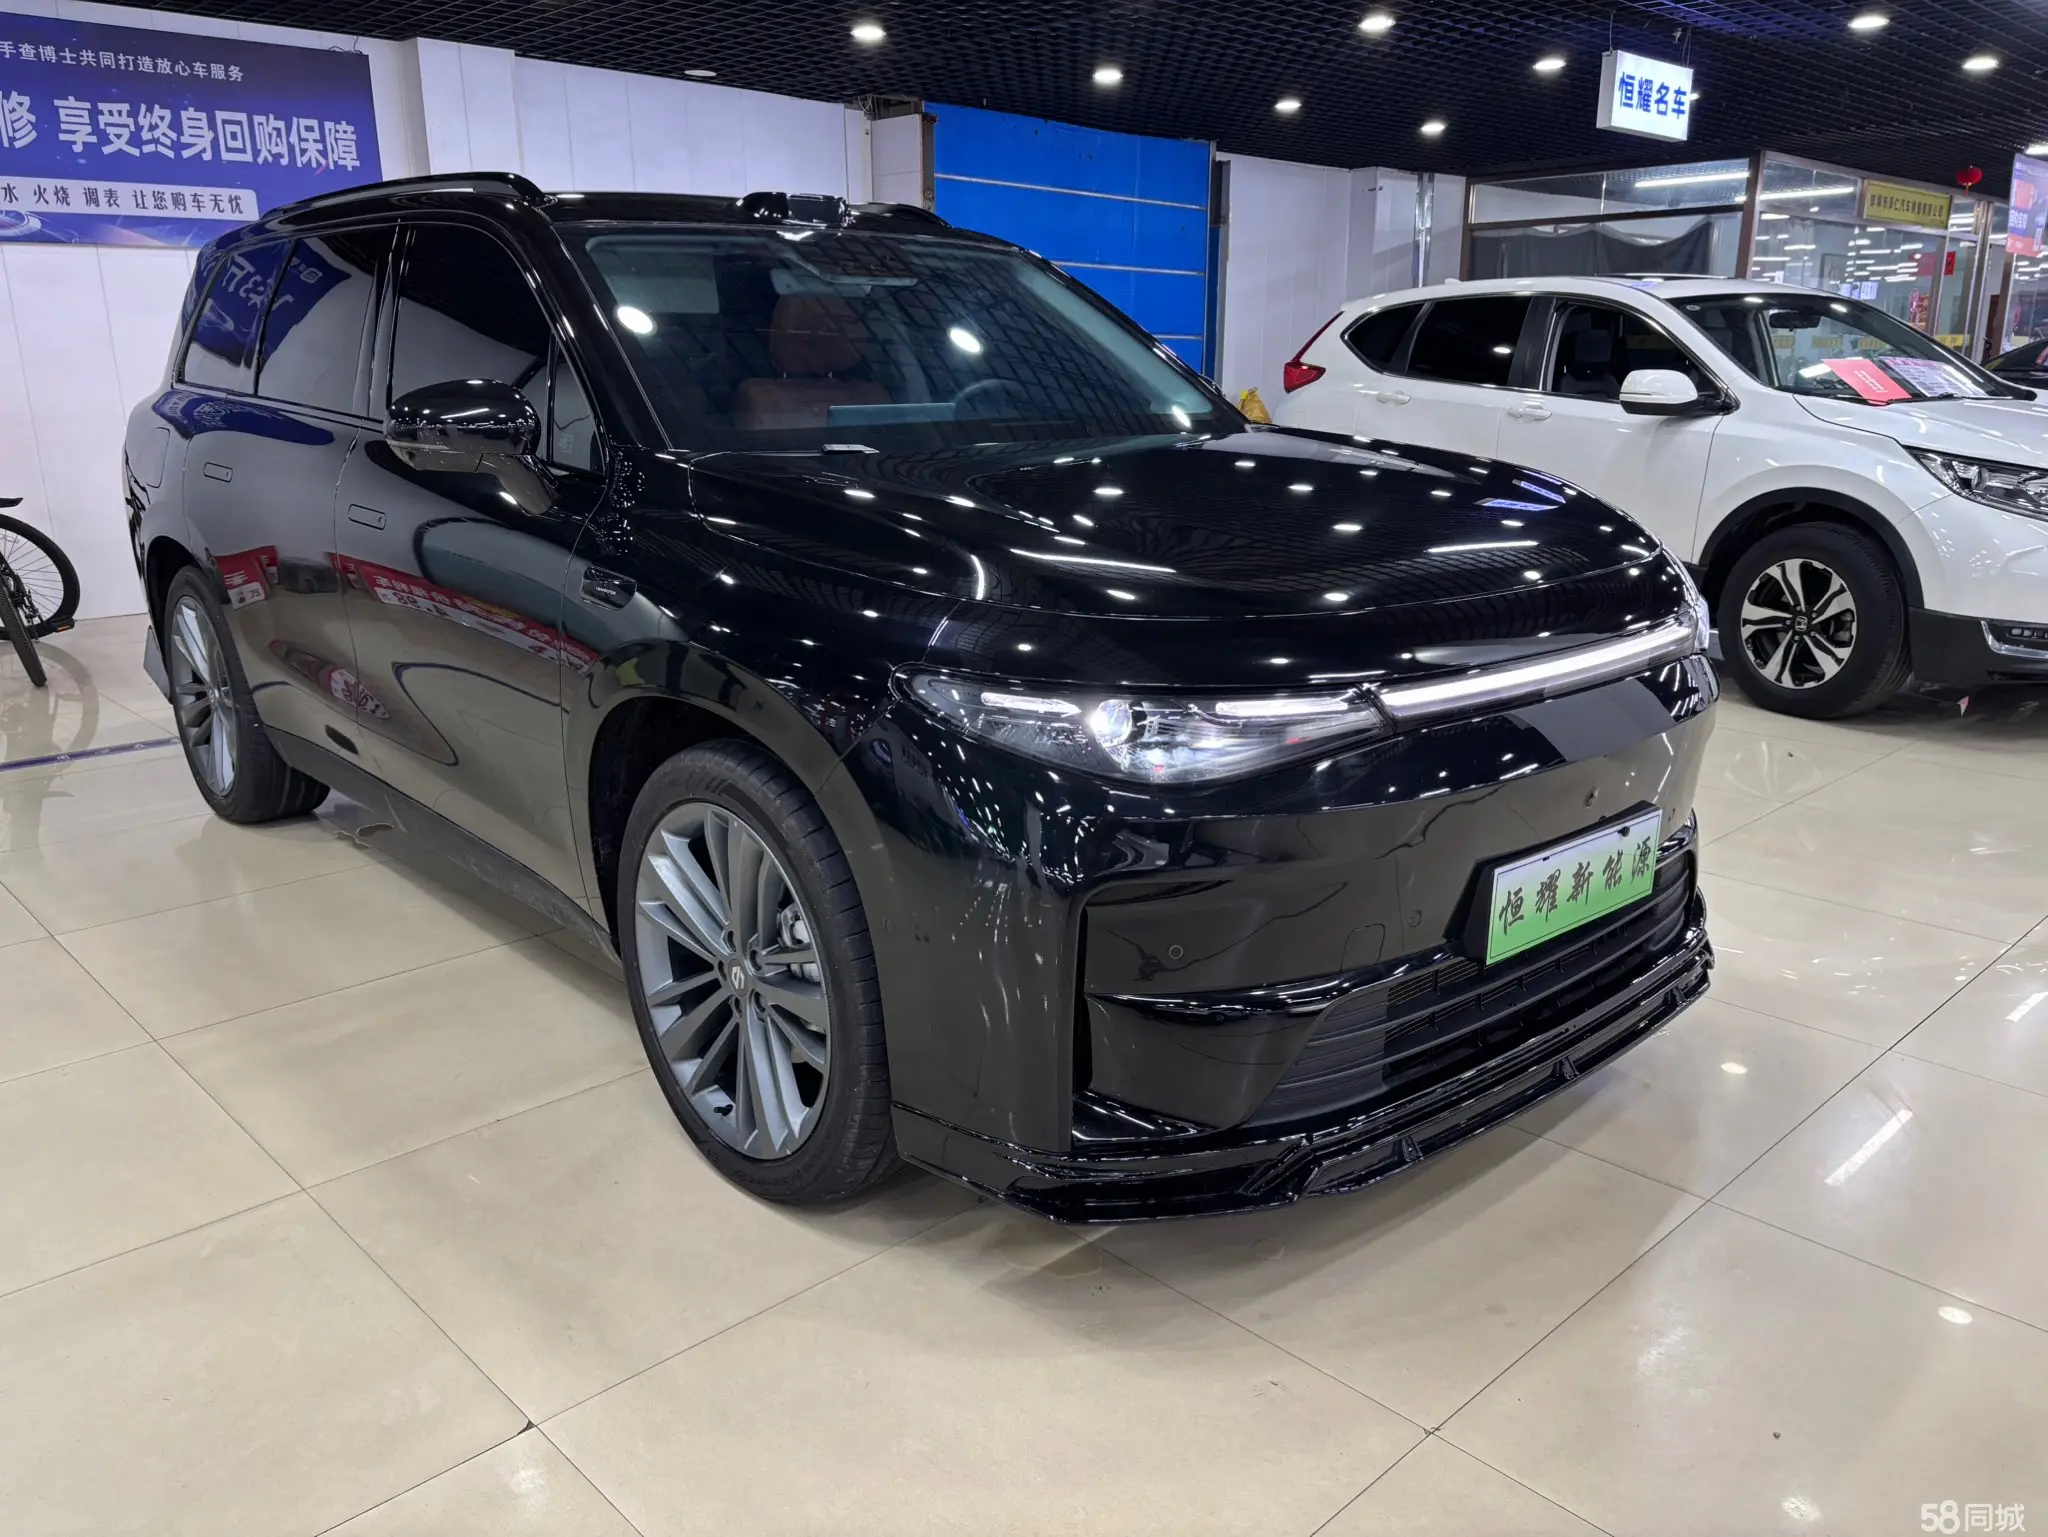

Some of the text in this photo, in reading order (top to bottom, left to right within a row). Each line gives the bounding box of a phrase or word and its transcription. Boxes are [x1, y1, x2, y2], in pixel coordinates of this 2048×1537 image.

[0, 41, 244, 82] 手查博士共同打造放心车服务
[1618, 72, 1687, 119] 恒耀名车
[0, 90, 361, 172] 修 享受终身回购保障
[0, 183, 244, 215] 水 火烧 调表 让您购车无忧
[1498, 835, 1652, 936] 恒耀新能源
